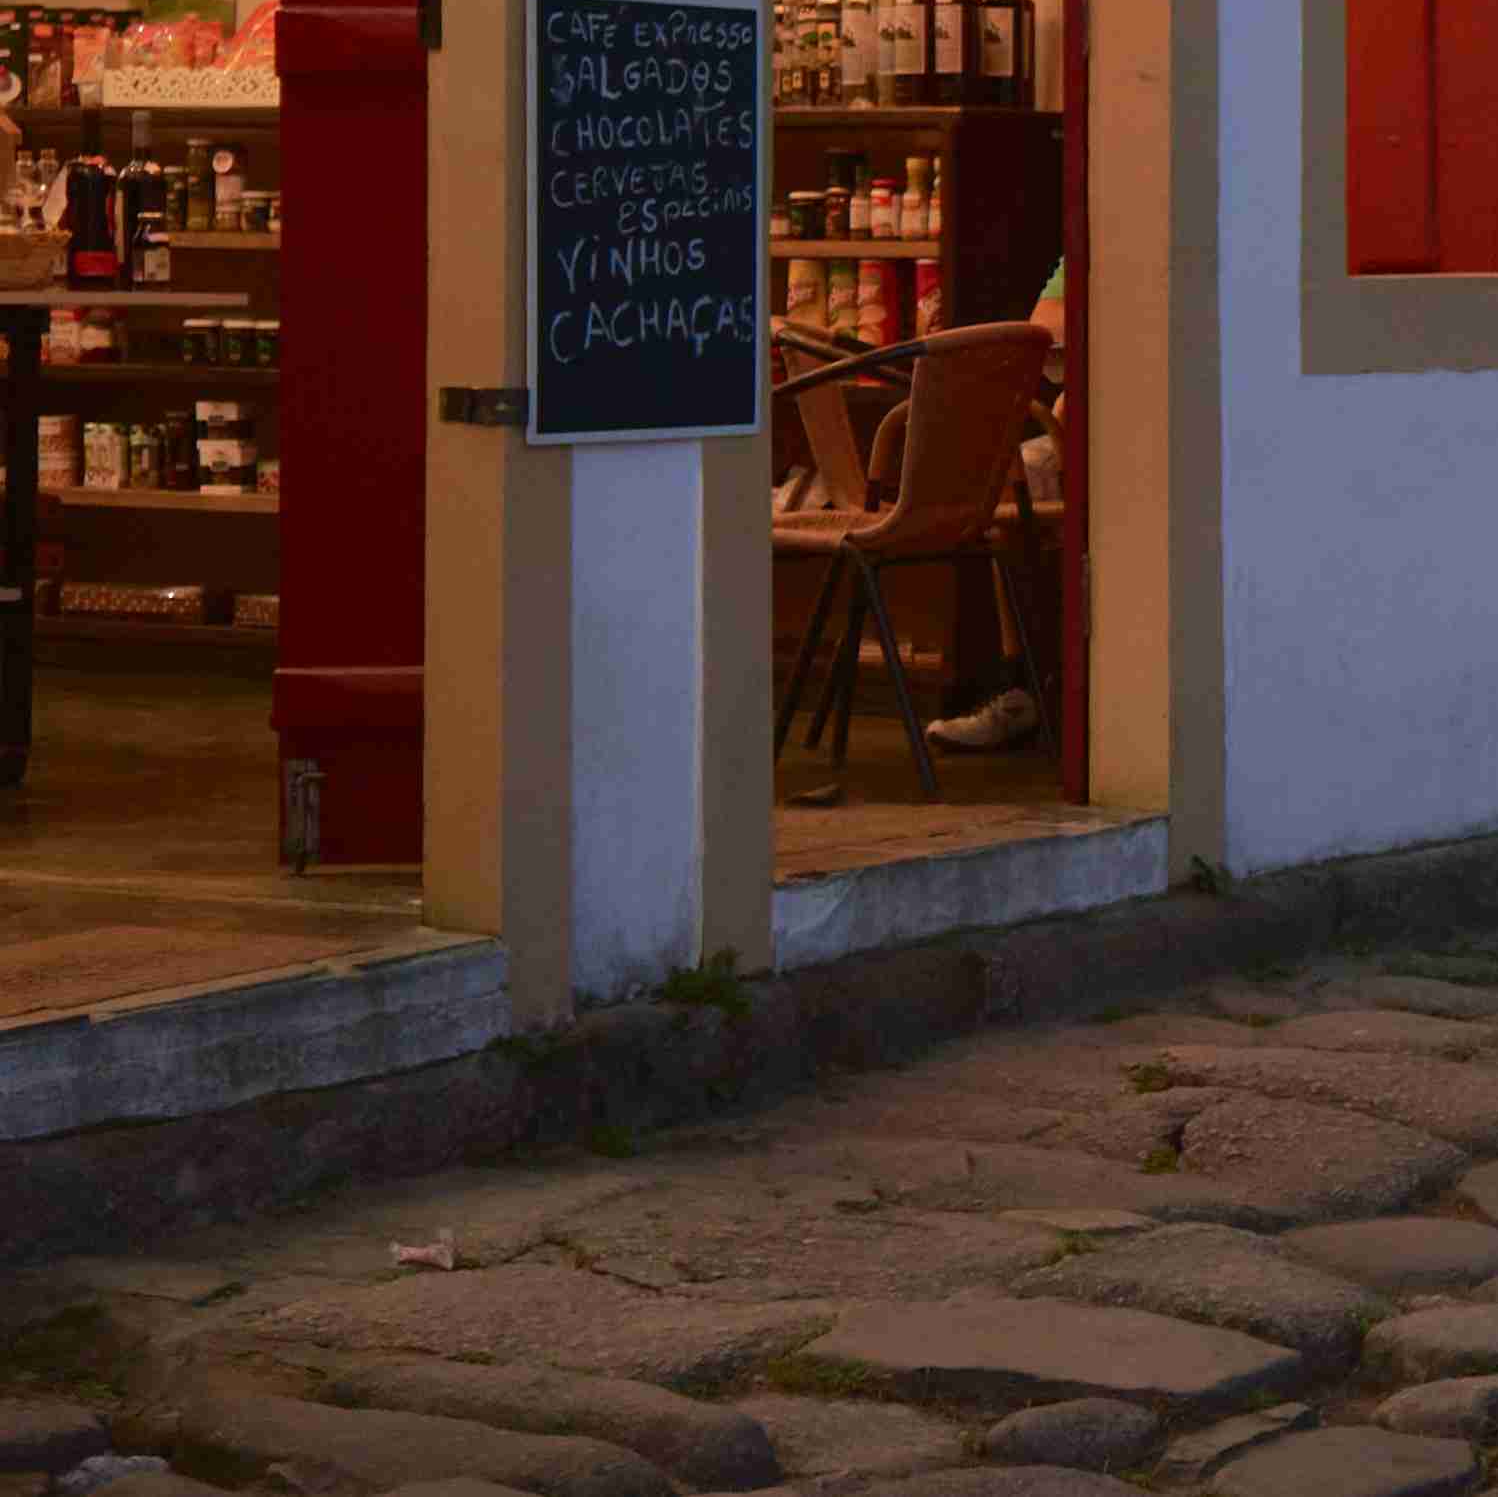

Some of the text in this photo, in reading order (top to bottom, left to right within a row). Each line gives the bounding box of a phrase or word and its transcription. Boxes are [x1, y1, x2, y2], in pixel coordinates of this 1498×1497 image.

[550, 53, 733, 104] SALGADOS
[551, 100, 753, 156] CHOCOLATES
[551, 160, 709, 209] CERVEJAS
[550, 294, 754, 364] CACHAÇAS
